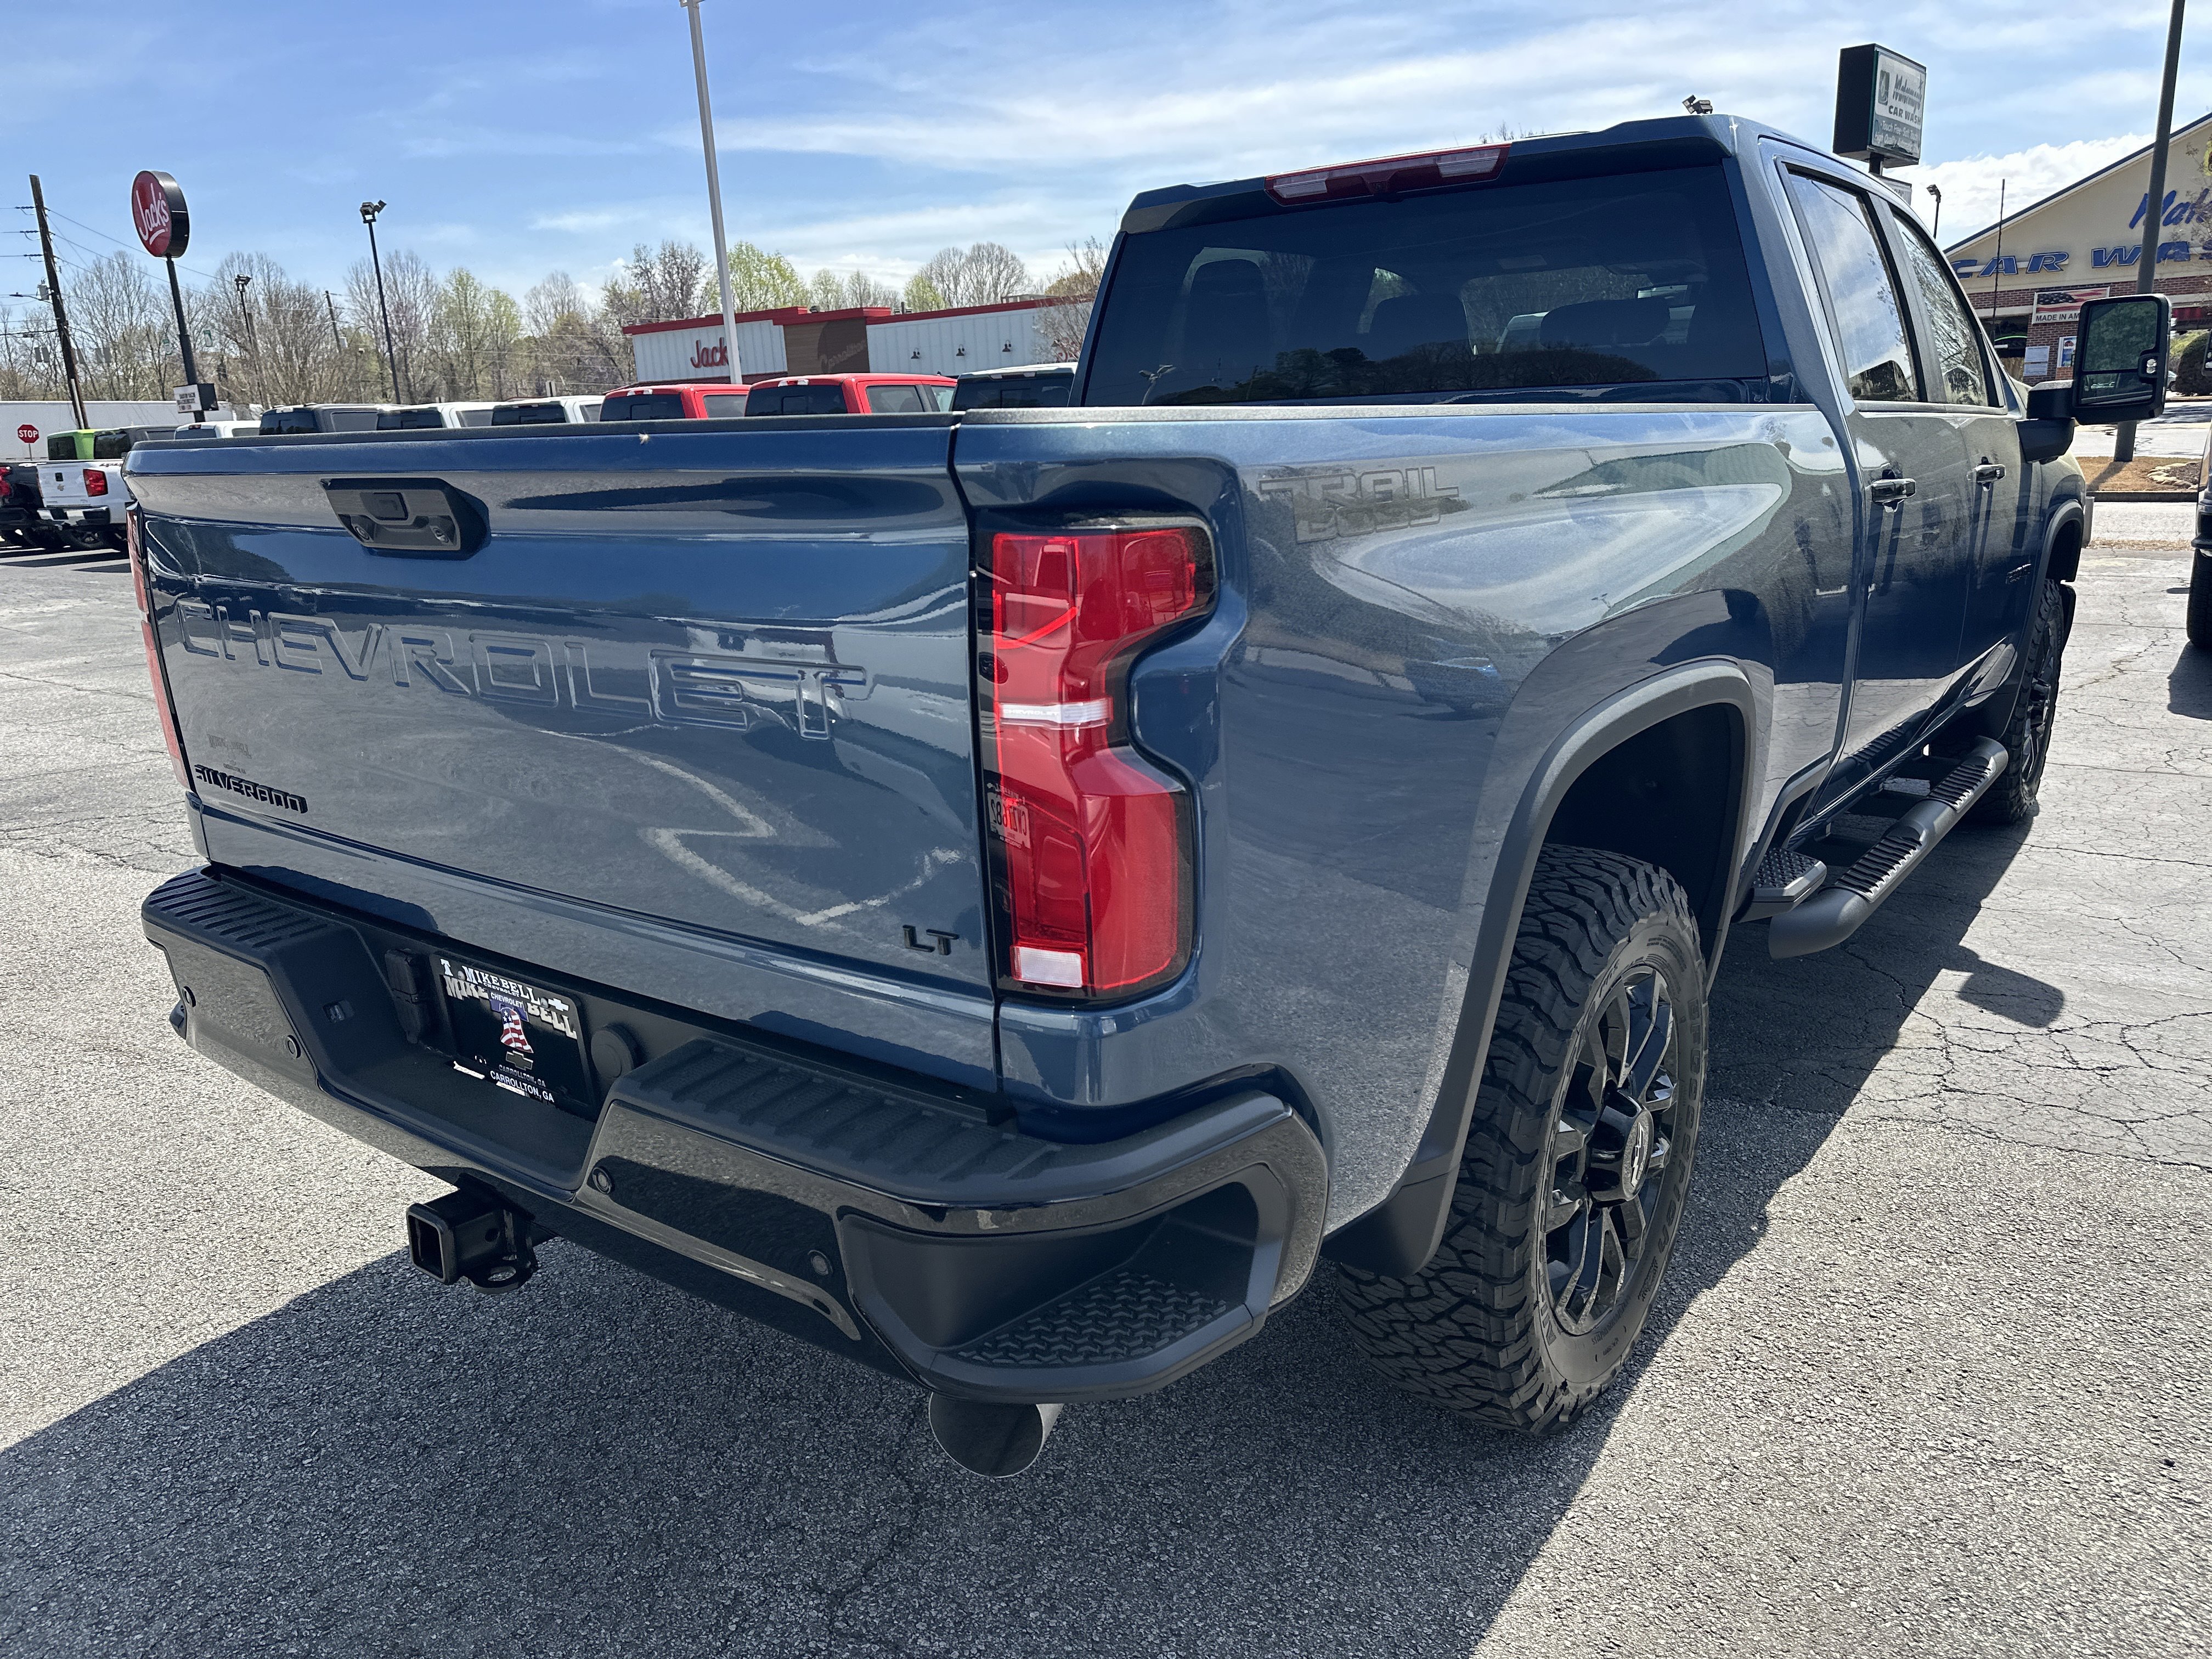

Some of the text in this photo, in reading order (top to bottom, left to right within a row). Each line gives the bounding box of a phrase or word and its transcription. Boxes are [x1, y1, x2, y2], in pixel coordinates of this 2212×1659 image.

[1888, 105, 1921, 126] CAR WASH
[136, 183, 170, 241] Jack's
[1950, 241, 2212, 278] CAR WA
[2035, 314, 2057, 322] MADE
[690, 337, 731, 368] Jack
[19, 430, 38, 438] STOP
[1259, 466, 1460, 509] TRAIL
[176, 600, 868, 741] CHEVROLET
[194, 764, 308, 814] SILVERADO
[902, 924, 960, 955] LT
[462, 965, 541, 1006] MIKE BELL
[483, 981, 520, 997] CHEVROLET
[490, 992, 523, 1008] CHEVROLET
[443, 974, 578, 1040] MIKE BELL
[490, 1070, 555, 1103] CARROLLTON, GA
[498, 1064, 546, 1087] CARROLLTON, GA
